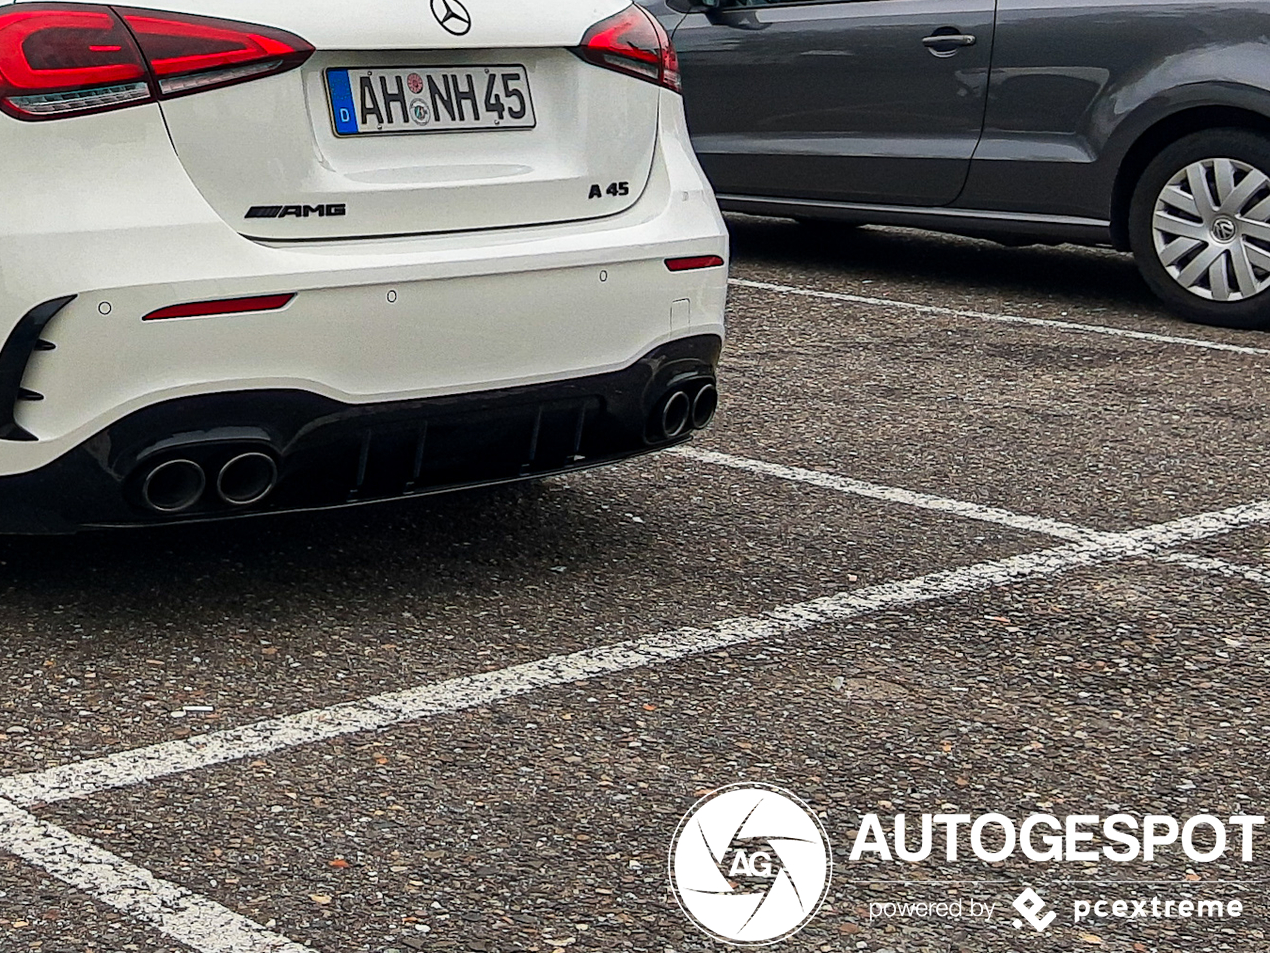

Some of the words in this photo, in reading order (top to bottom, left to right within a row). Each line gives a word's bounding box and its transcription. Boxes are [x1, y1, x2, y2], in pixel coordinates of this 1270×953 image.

[359, 75, 410, 124] AH
[426, 74, 480, 122] NH
[484, 73, 526, 120] 45
[339, 108, 350, 123] D
[588, 184, 602, 199] A
[606, 181, 629, 197] 45
[277, 203, 346, 218] AMG
